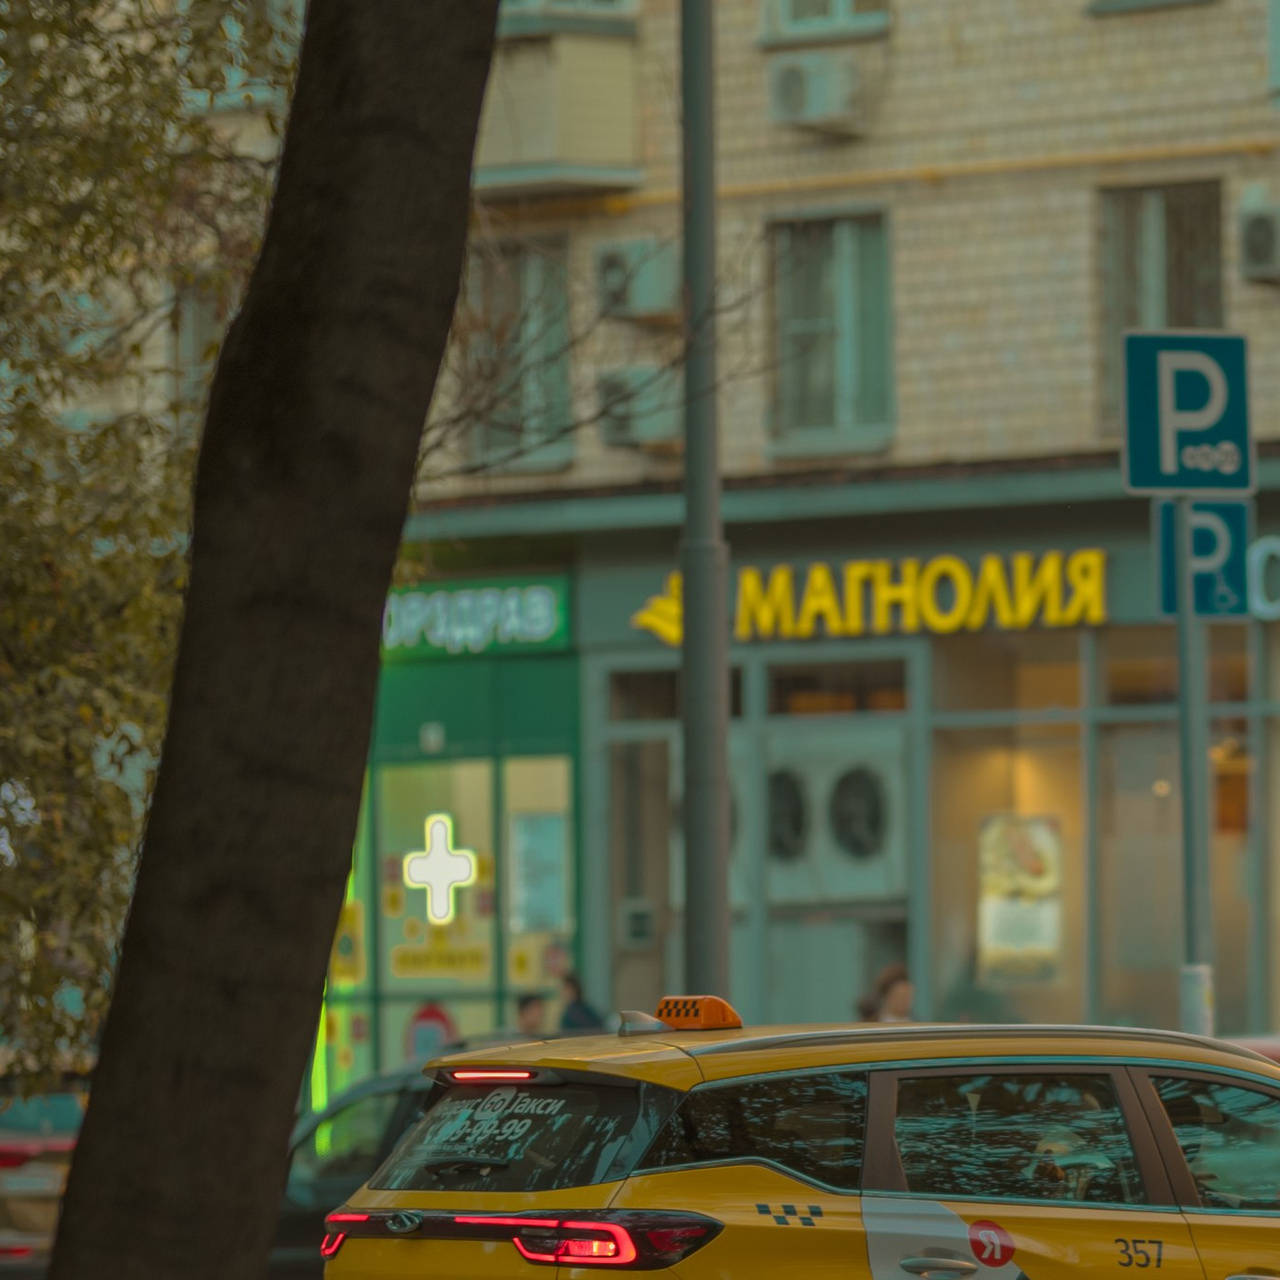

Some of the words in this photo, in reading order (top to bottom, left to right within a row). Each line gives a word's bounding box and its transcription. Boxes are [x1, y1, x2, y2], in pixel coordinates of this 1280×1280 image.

[1156, 350, 1230, 475] P
[735, 549, 1105, 641] МАГНОЛИЯ
[1184, 510, 1231, 613] P
[505, 1093, 567, 1115] Такси
[1114, 1238, 1163, 1268] 357
